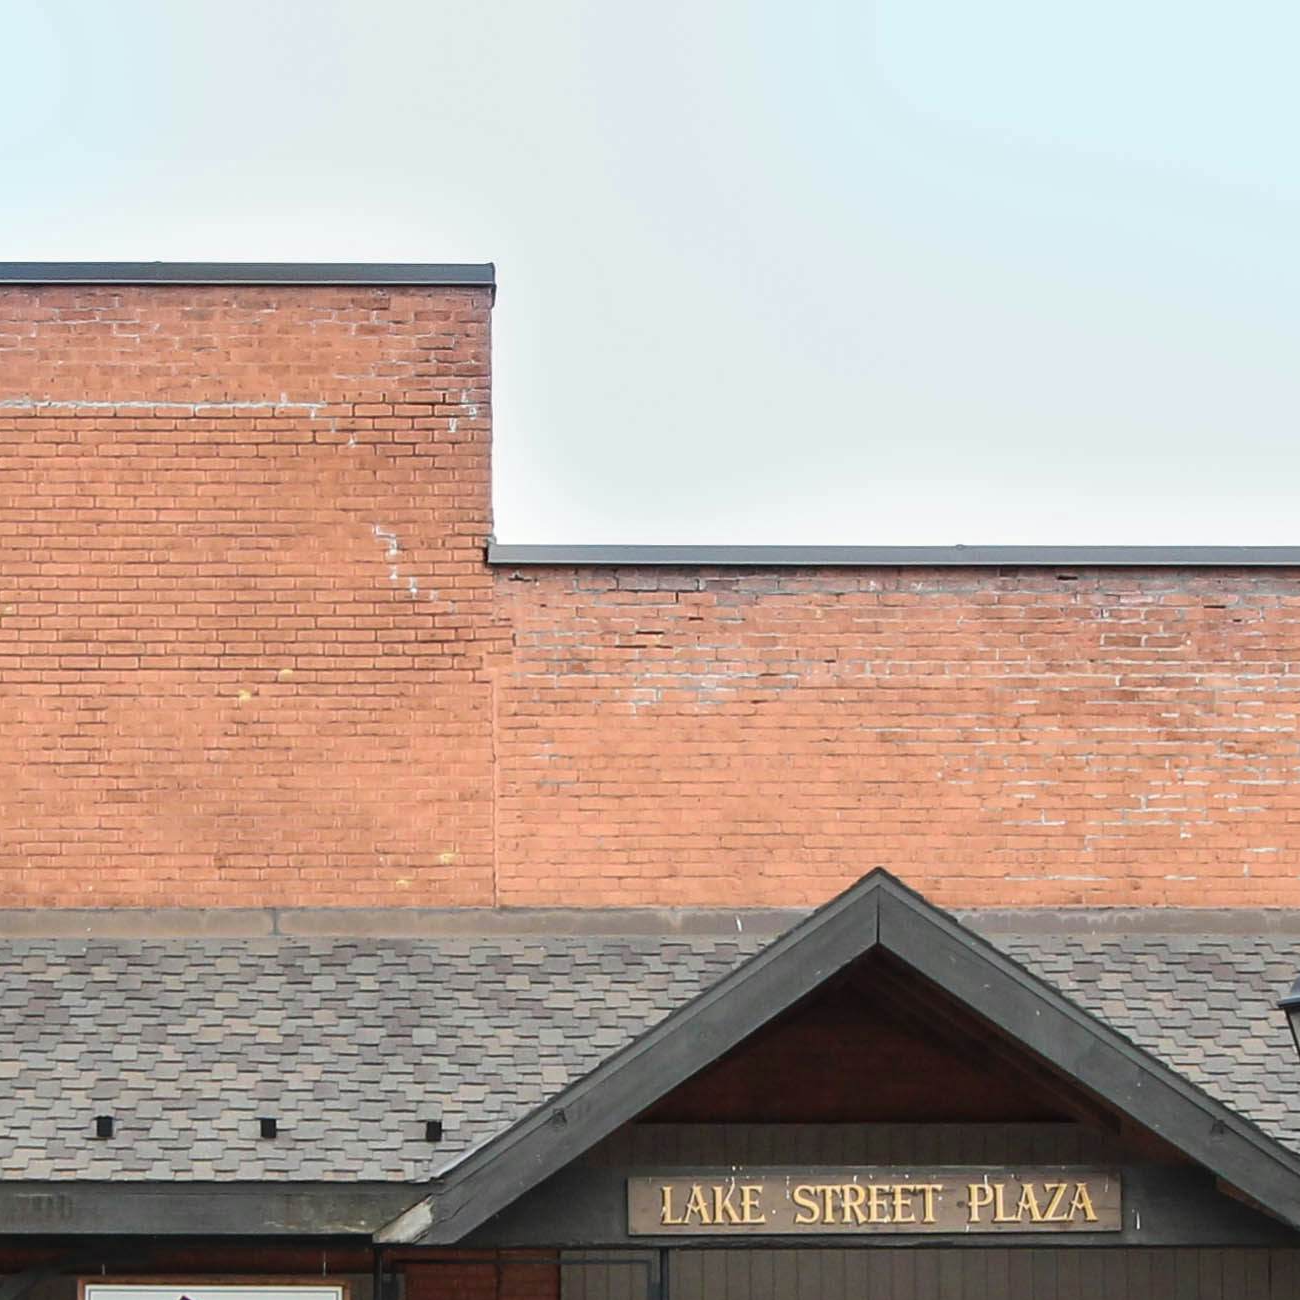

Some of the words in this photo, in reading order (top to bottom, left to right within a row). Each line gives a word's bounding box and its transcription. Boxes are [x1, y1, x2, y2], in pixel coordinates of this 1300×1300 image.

[660, 1184, 767, 1226] LAKE
[792, 1184, 942, 1226] STREET
[967, 1183, 1099, 1223] PLAZA
